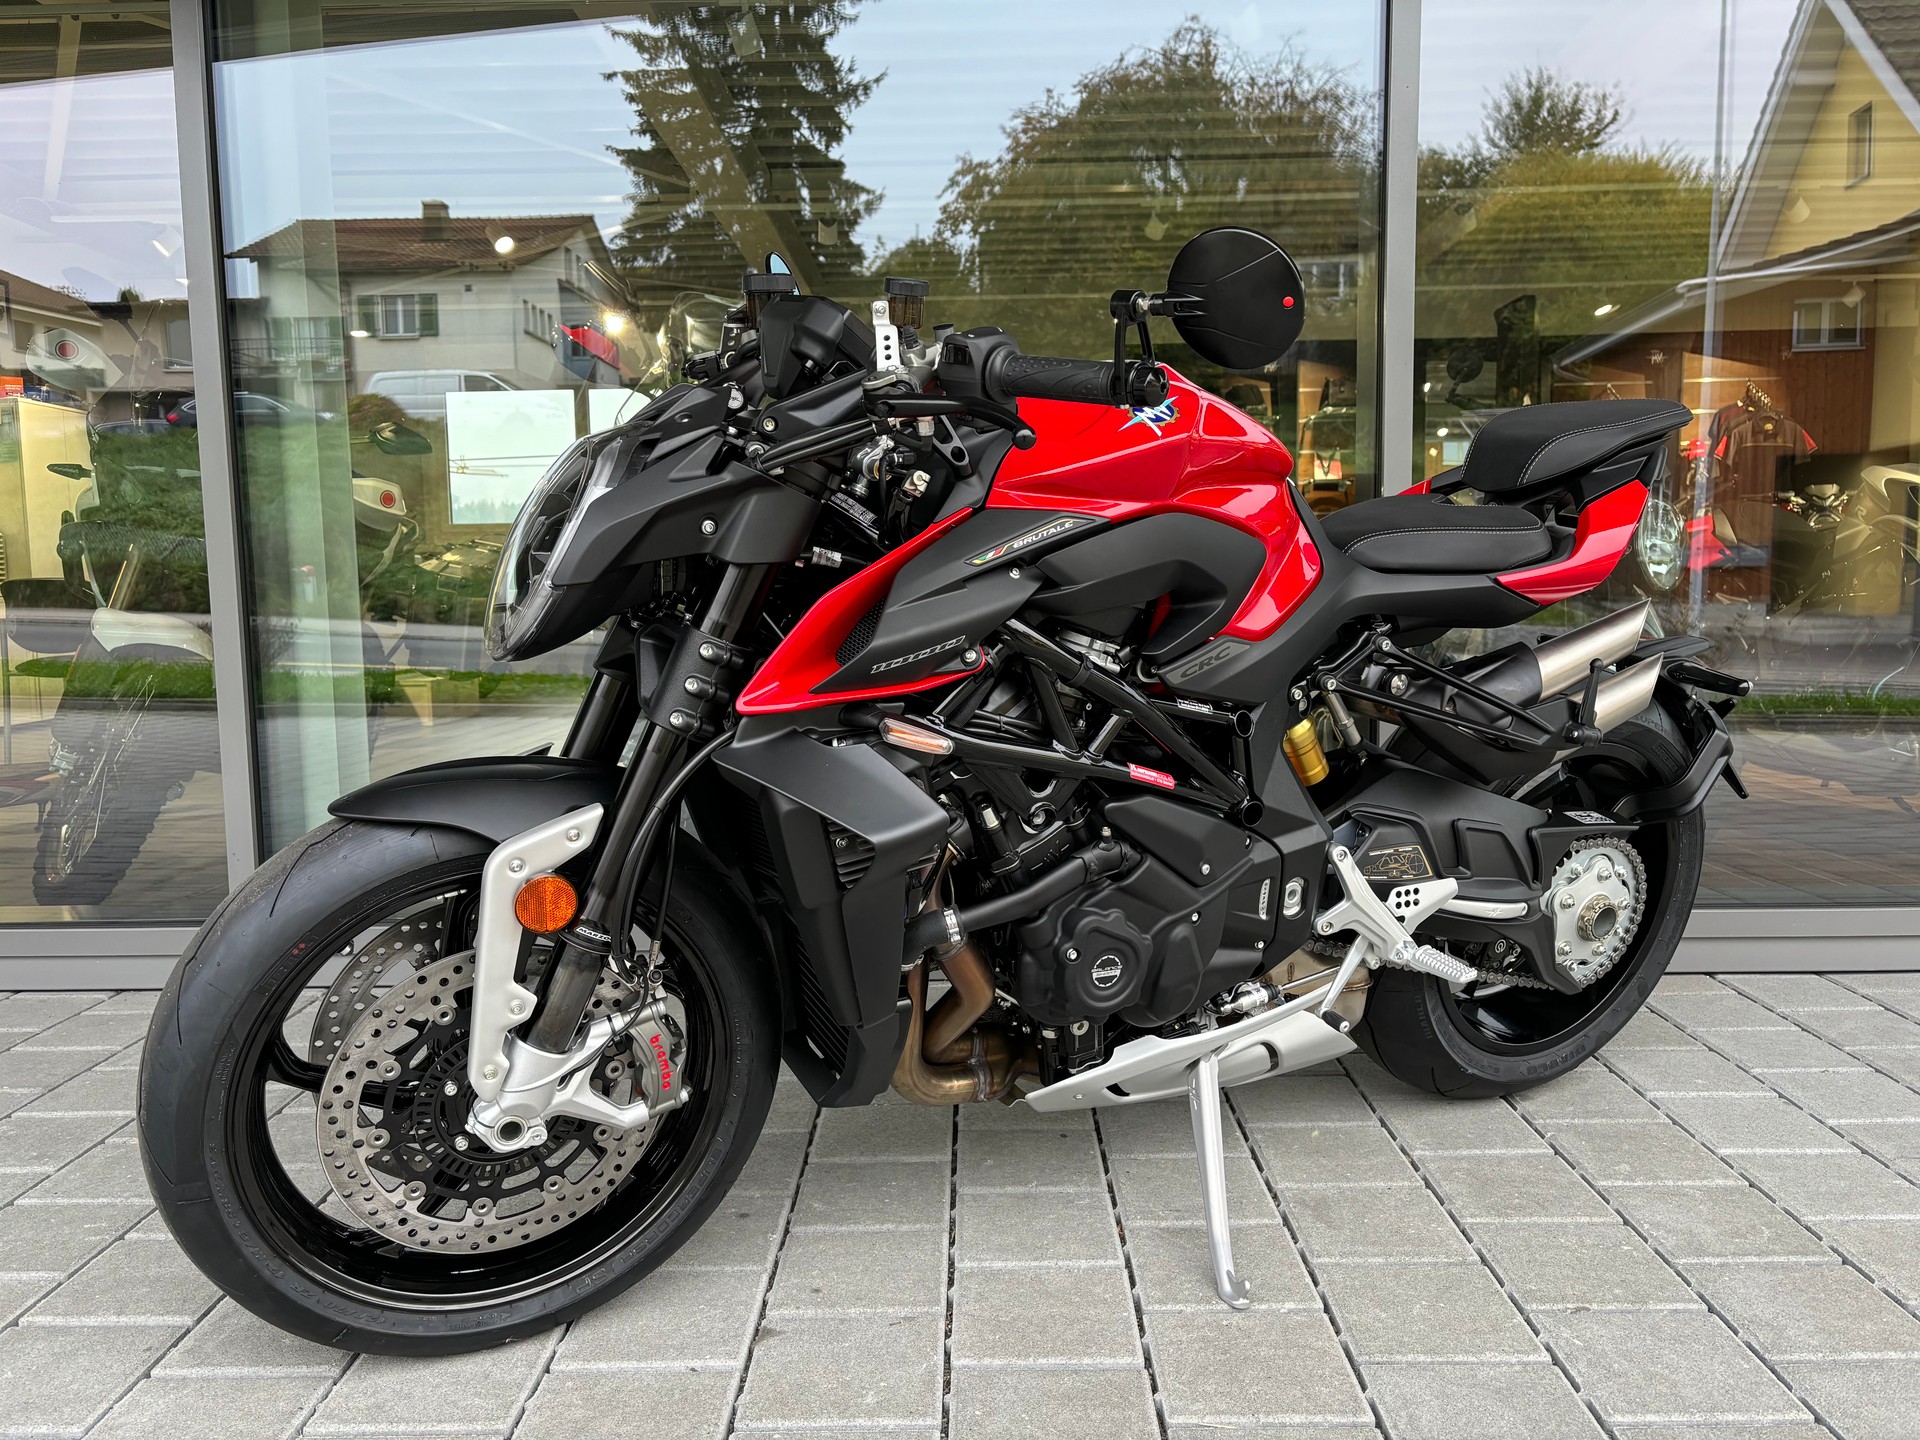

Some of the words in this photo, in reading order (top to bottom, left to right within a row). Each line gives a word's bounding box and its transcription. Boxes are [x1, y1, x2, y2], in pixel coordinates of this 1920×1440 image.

[1013, 520, 1073, 549] BRUTALE
[870, 635, 966, 674] 1000
[1180, 645, 1230, 678] CRC
[577, 926, 611, 942] MARZO
[649, 1033, 674, 1091] brembo
